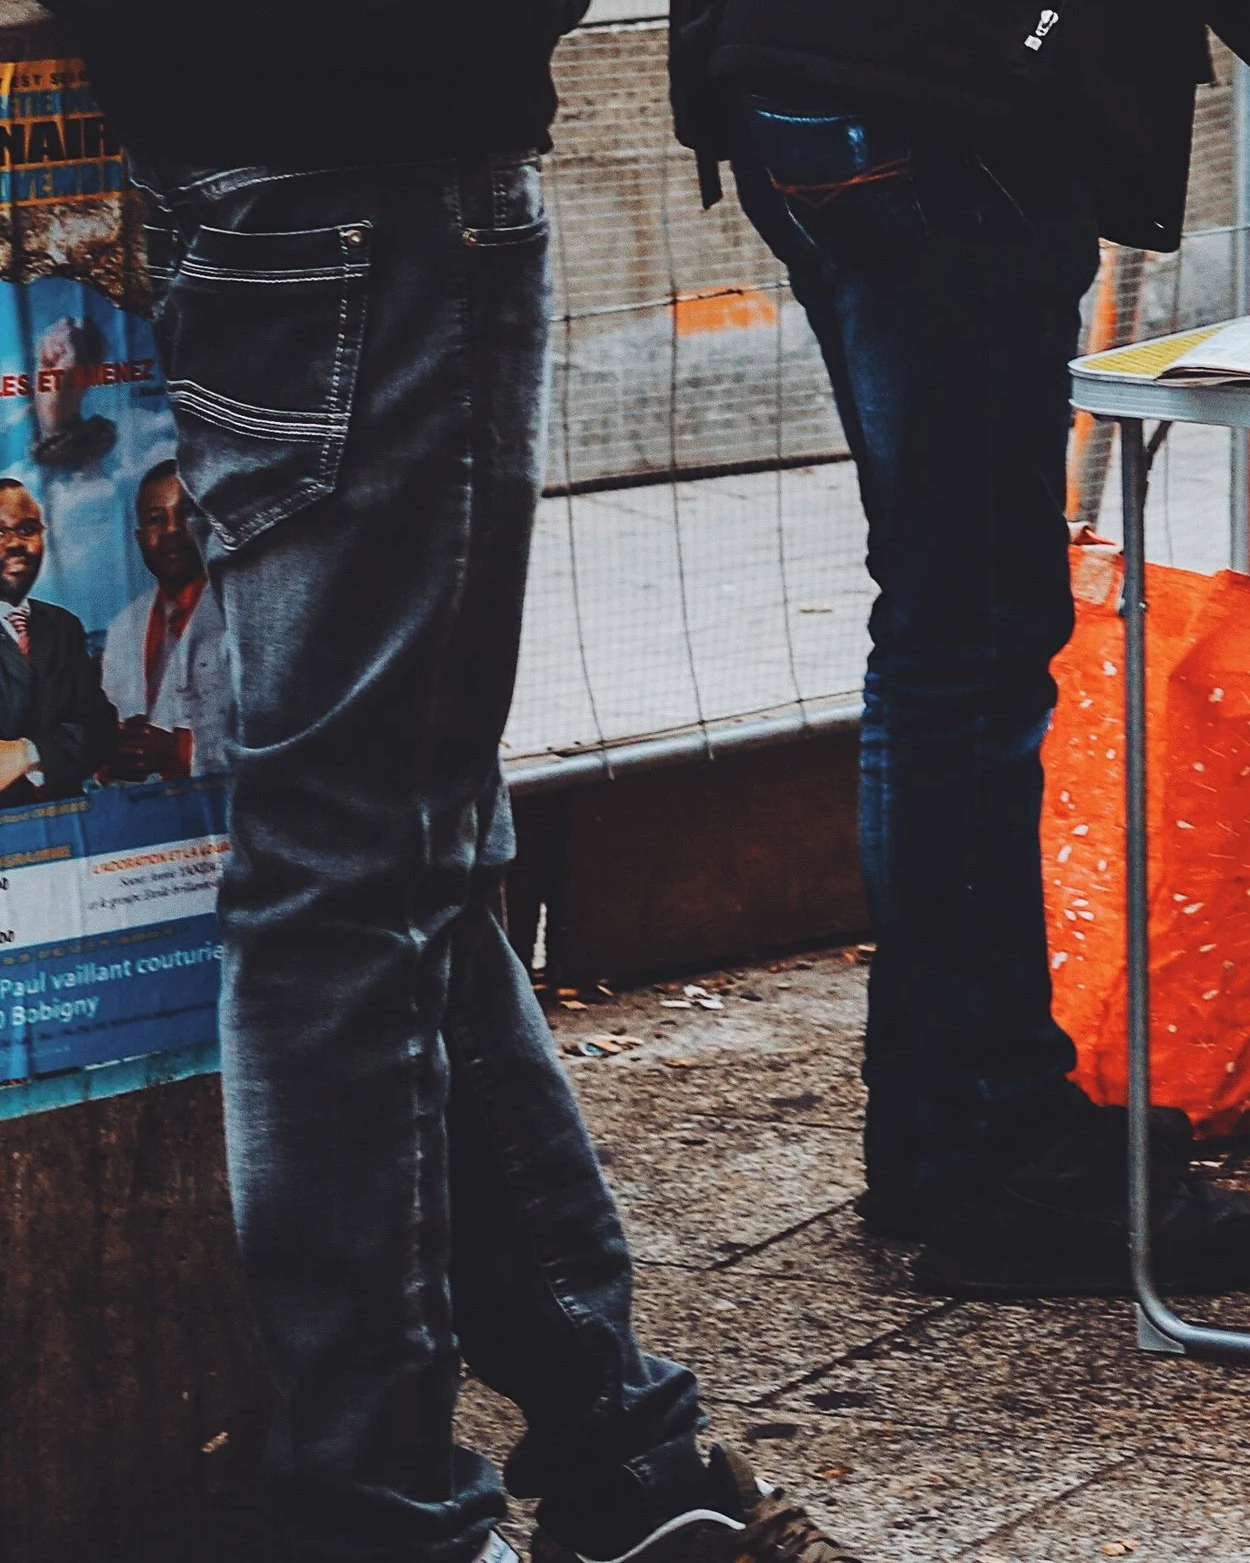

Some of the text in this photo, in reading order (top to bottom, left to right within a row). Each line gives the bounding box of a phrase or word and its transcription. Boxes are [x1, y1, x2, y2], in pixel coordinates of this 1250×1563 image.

[38, 368, 65, 392] ET
[0, 971, 46, 1000] Paul
[52, 959, 133, 990] vaillant
[136, 940, 225, 975] couturie
[12, 995, 100, 1026] Bobigny
